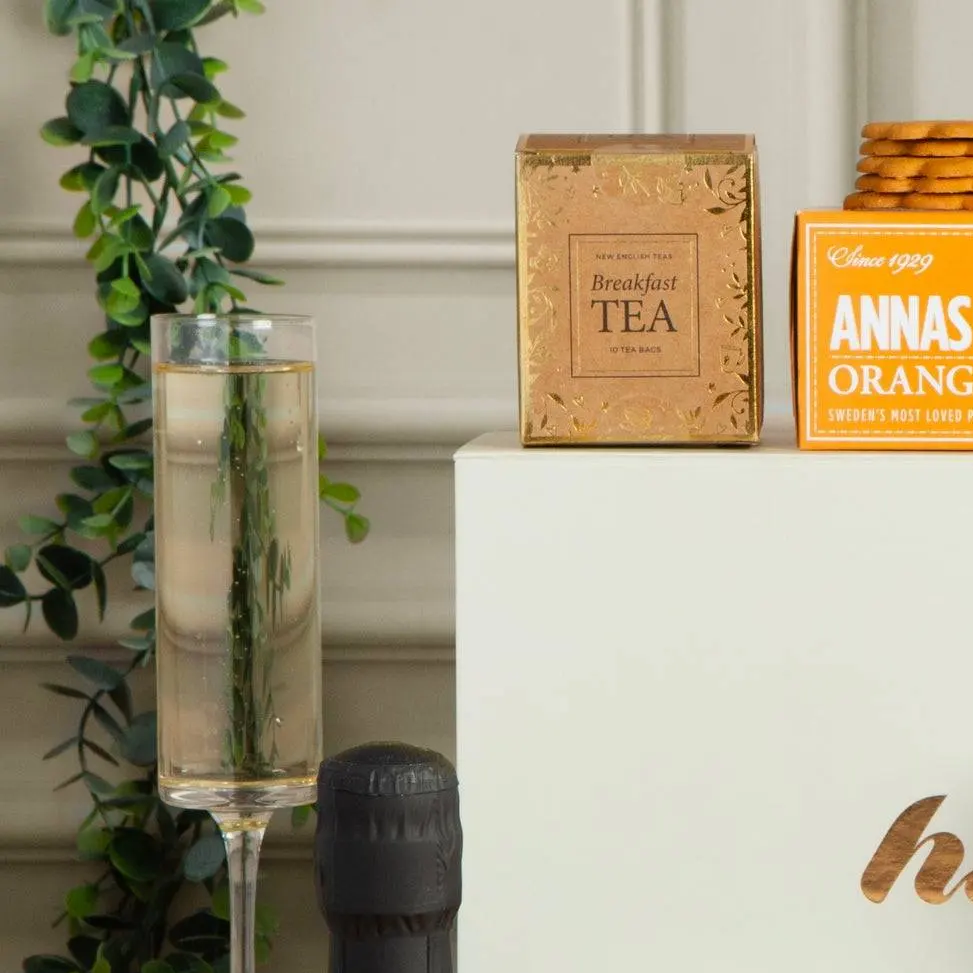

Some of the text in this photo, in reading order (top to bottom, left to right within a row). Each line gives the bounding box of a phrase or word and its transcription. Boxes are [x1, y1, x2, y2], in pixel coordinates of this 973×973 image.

[827, 245, 934, 275] Since 1929
[590, 273, 678, 296] Breakfast
[590, 299, 678, 333] TEA
[829, 294, 973, 352] ANNAS
[828, 408, 886, 423] SWEDEN'S
[891, 408, 921, 423] MOST
[926, 408, 962, 423] LOVED
